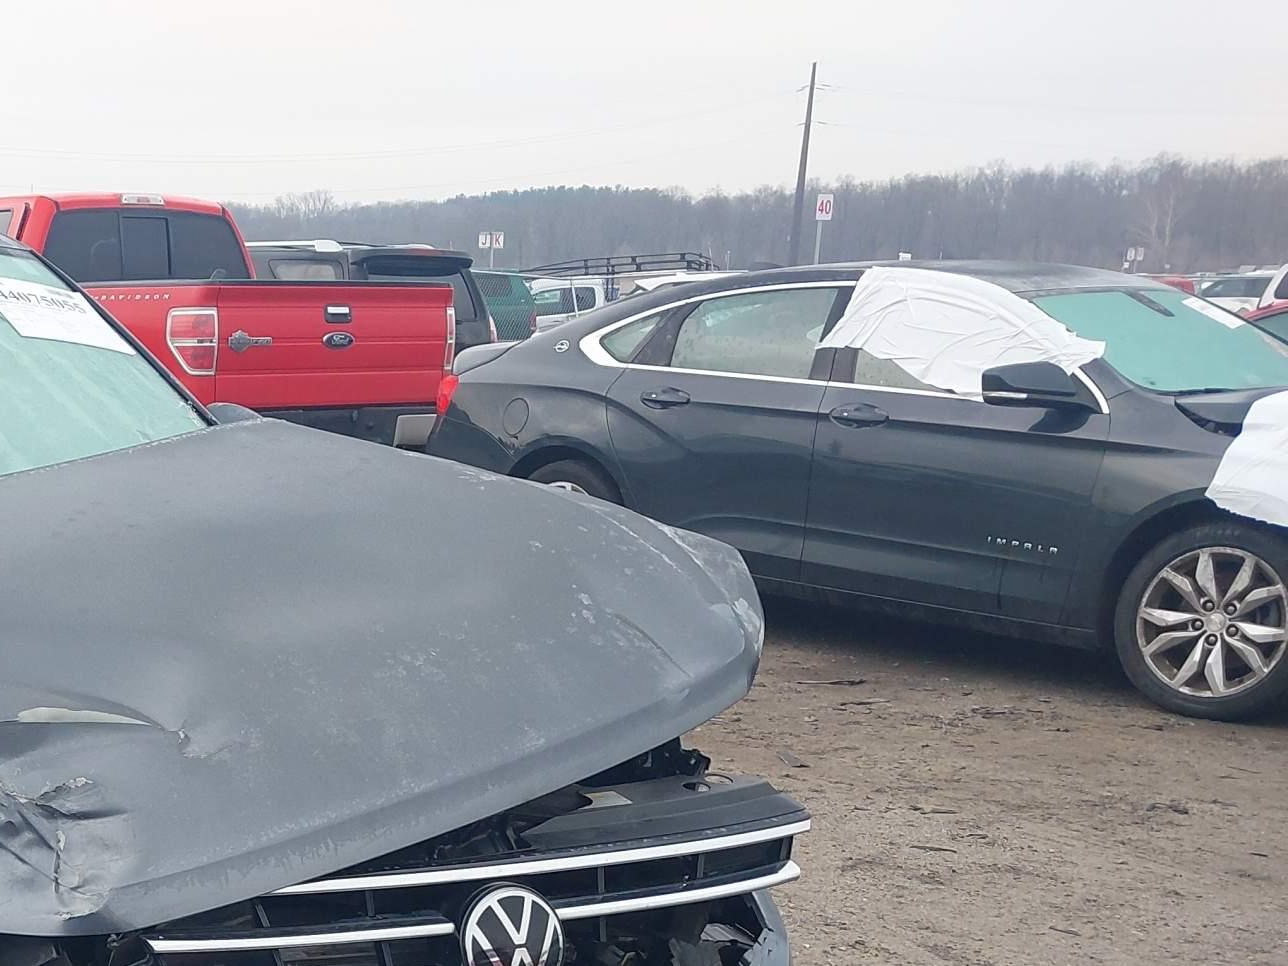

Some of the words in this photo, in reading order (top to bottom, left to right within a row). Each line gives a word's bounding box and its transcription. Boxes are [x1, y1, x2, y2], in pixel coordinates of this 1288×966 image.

[818, 199, 832, 215] 40
[481, 233, 488, 246] J
[494, 234, 502, 246] K
[987, 535, 1058, 556] IMPALA
